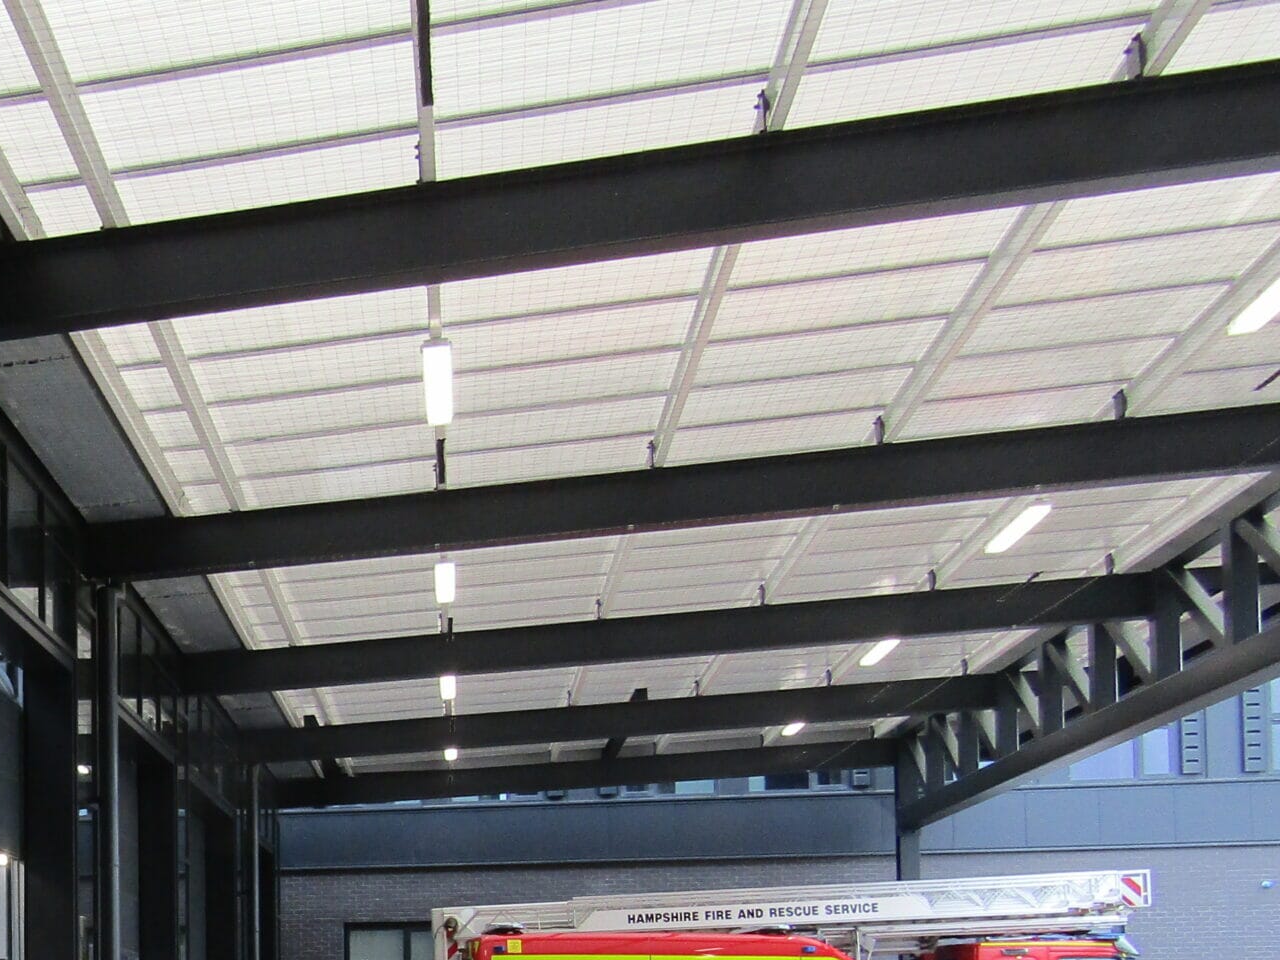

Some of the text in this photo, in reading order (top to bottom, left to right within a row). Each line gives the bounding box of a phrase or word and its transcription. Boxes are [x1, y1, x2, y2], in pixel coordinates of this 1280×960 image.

[627, 902, 879, 924] HAMPSHIRE FIRE AND RESCUE SERVICE
